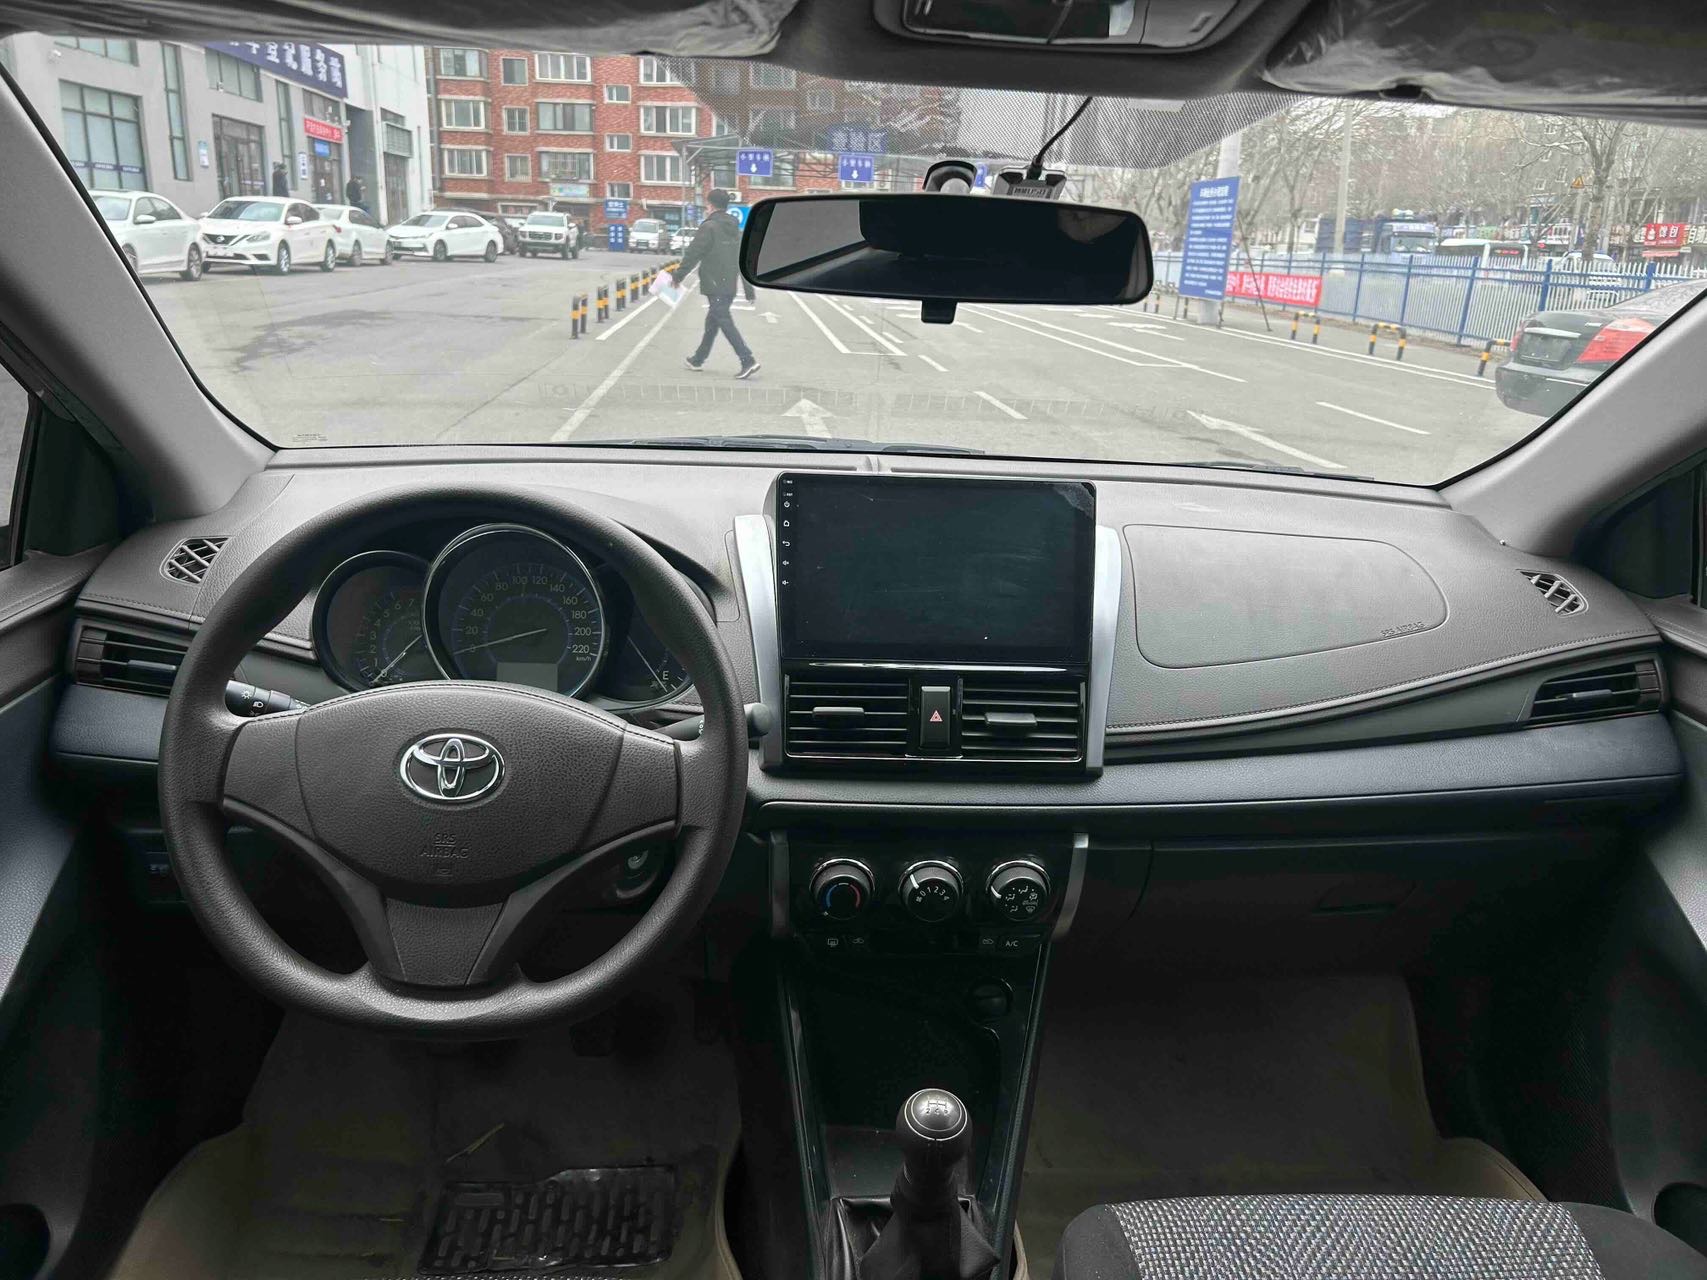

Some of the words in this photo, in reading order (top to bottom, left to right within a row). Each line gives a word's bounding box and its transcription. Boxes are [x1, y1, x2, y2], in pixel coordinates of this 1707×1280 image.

[512, 576, 528, 585] 100
[532, 576, 548, 585] 120
[495, 582, 509, 591] 80
[550, 584, 565, 593] 140
[480, 593, 494, 602] 60
[563, 596, 578, 605] 160
[395, 601, 401, 610] 6
[383, 609, 390, 618] 5
[470, 609, 484, 617] 40
[572, 610, 587, 619] 180
[374, 618, 381, 627] 4
[465, 625, 479, 635] 20
[574, 626, 592, 636] 200
[370, 631, 377, 640] 3
[369, 645, 376, 654] 2
[572, 644, 590, 654] 220
[662, 670, 670, 680] E
[433, 832, 457, 844] SRS
[420, 847, 470, 859] AIRBAG
